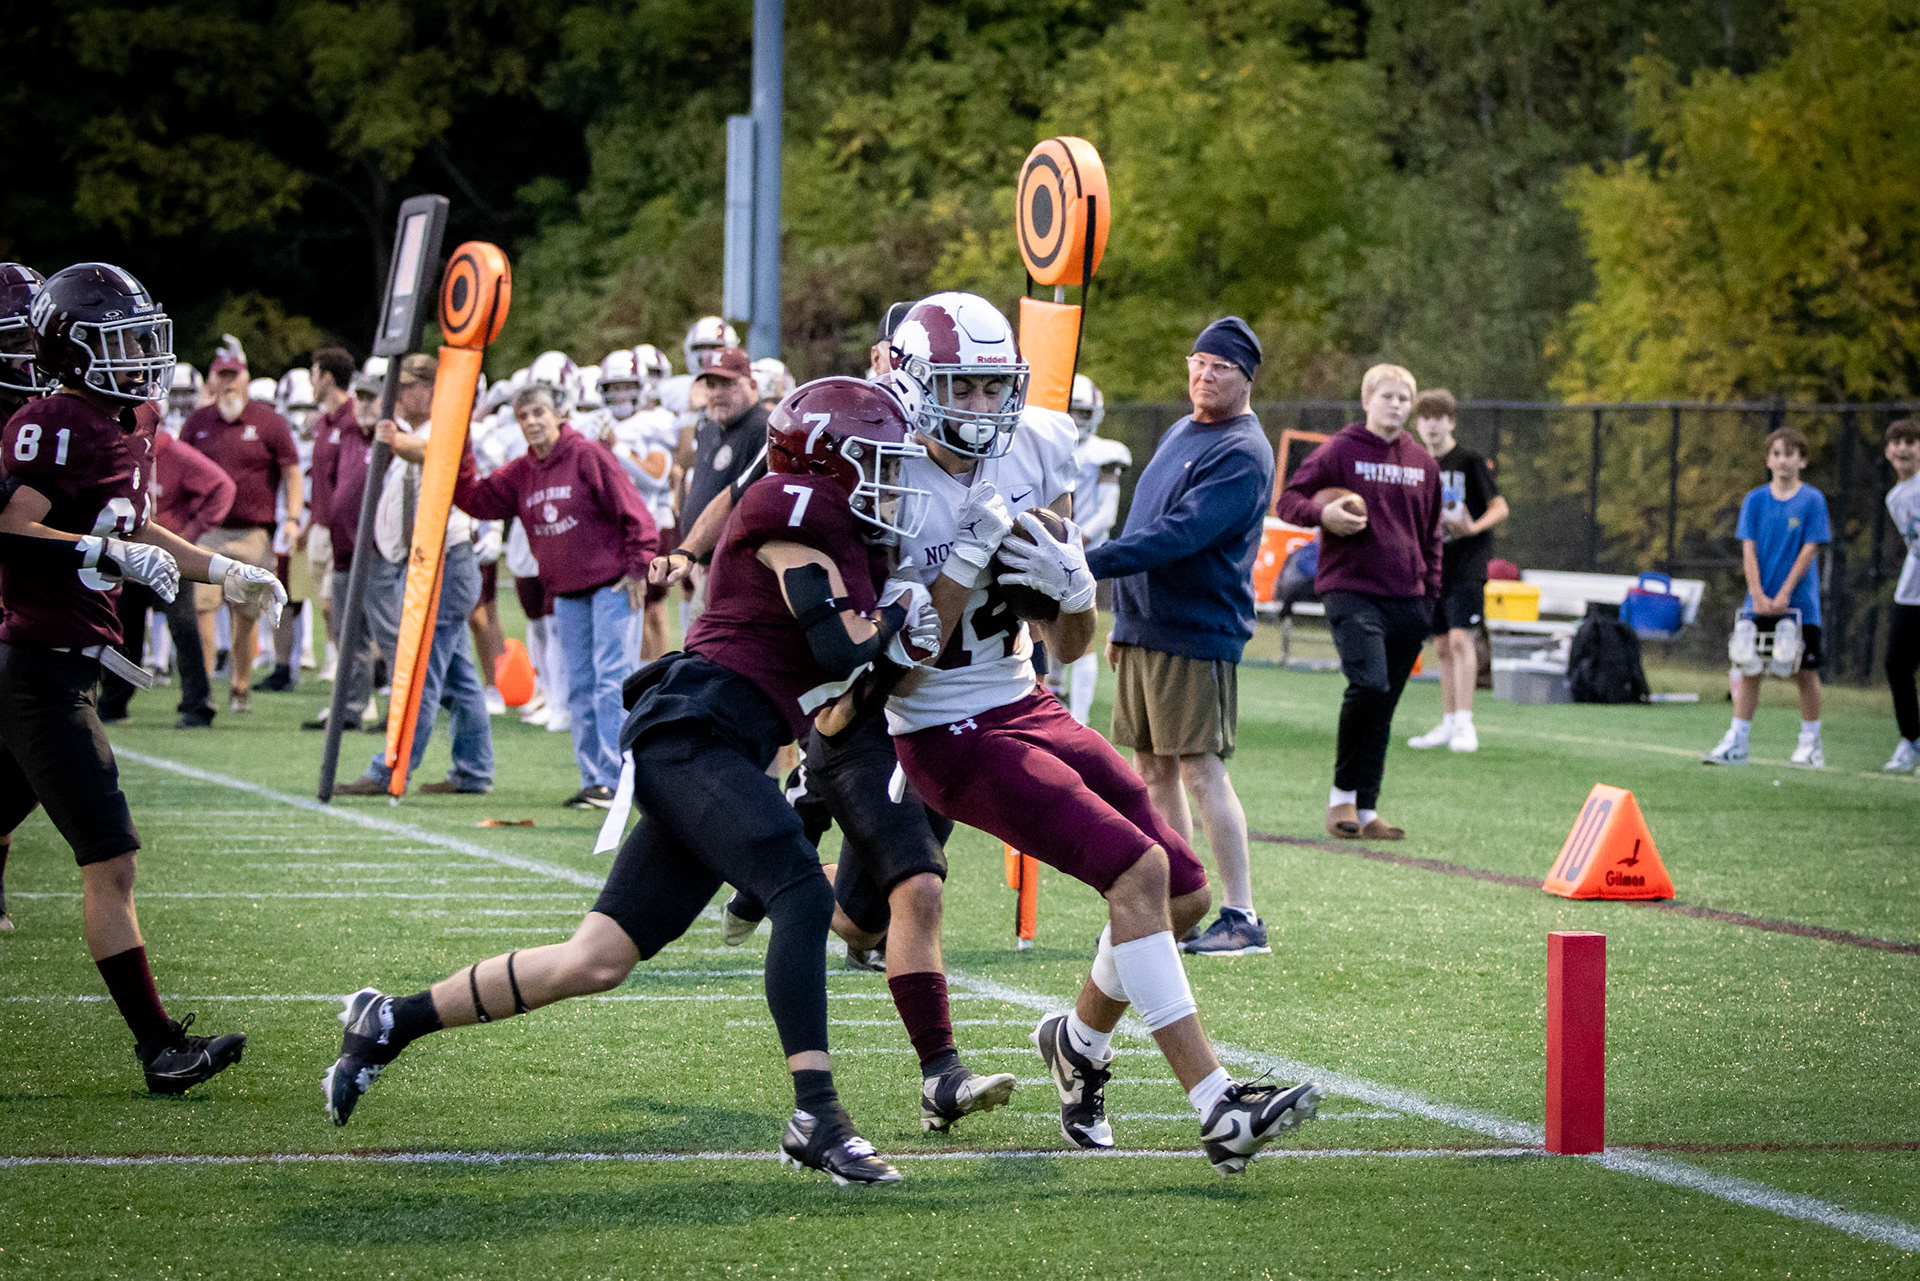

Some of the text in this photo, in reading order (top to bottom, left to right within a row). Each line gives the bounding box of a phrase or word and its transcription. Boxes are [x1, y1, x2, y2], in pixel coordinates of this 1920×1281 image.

[30, 292, 57, 337] 81
[977, 355, 1007, 363] Riddell
[14, 423, 71, 466] 81
[802, 412, 831, 454] 7
[782, 484, 814, 527] 7
[1556, 797, 1613, 882] 10
[1605, 870, 1645, 887] Gilman
